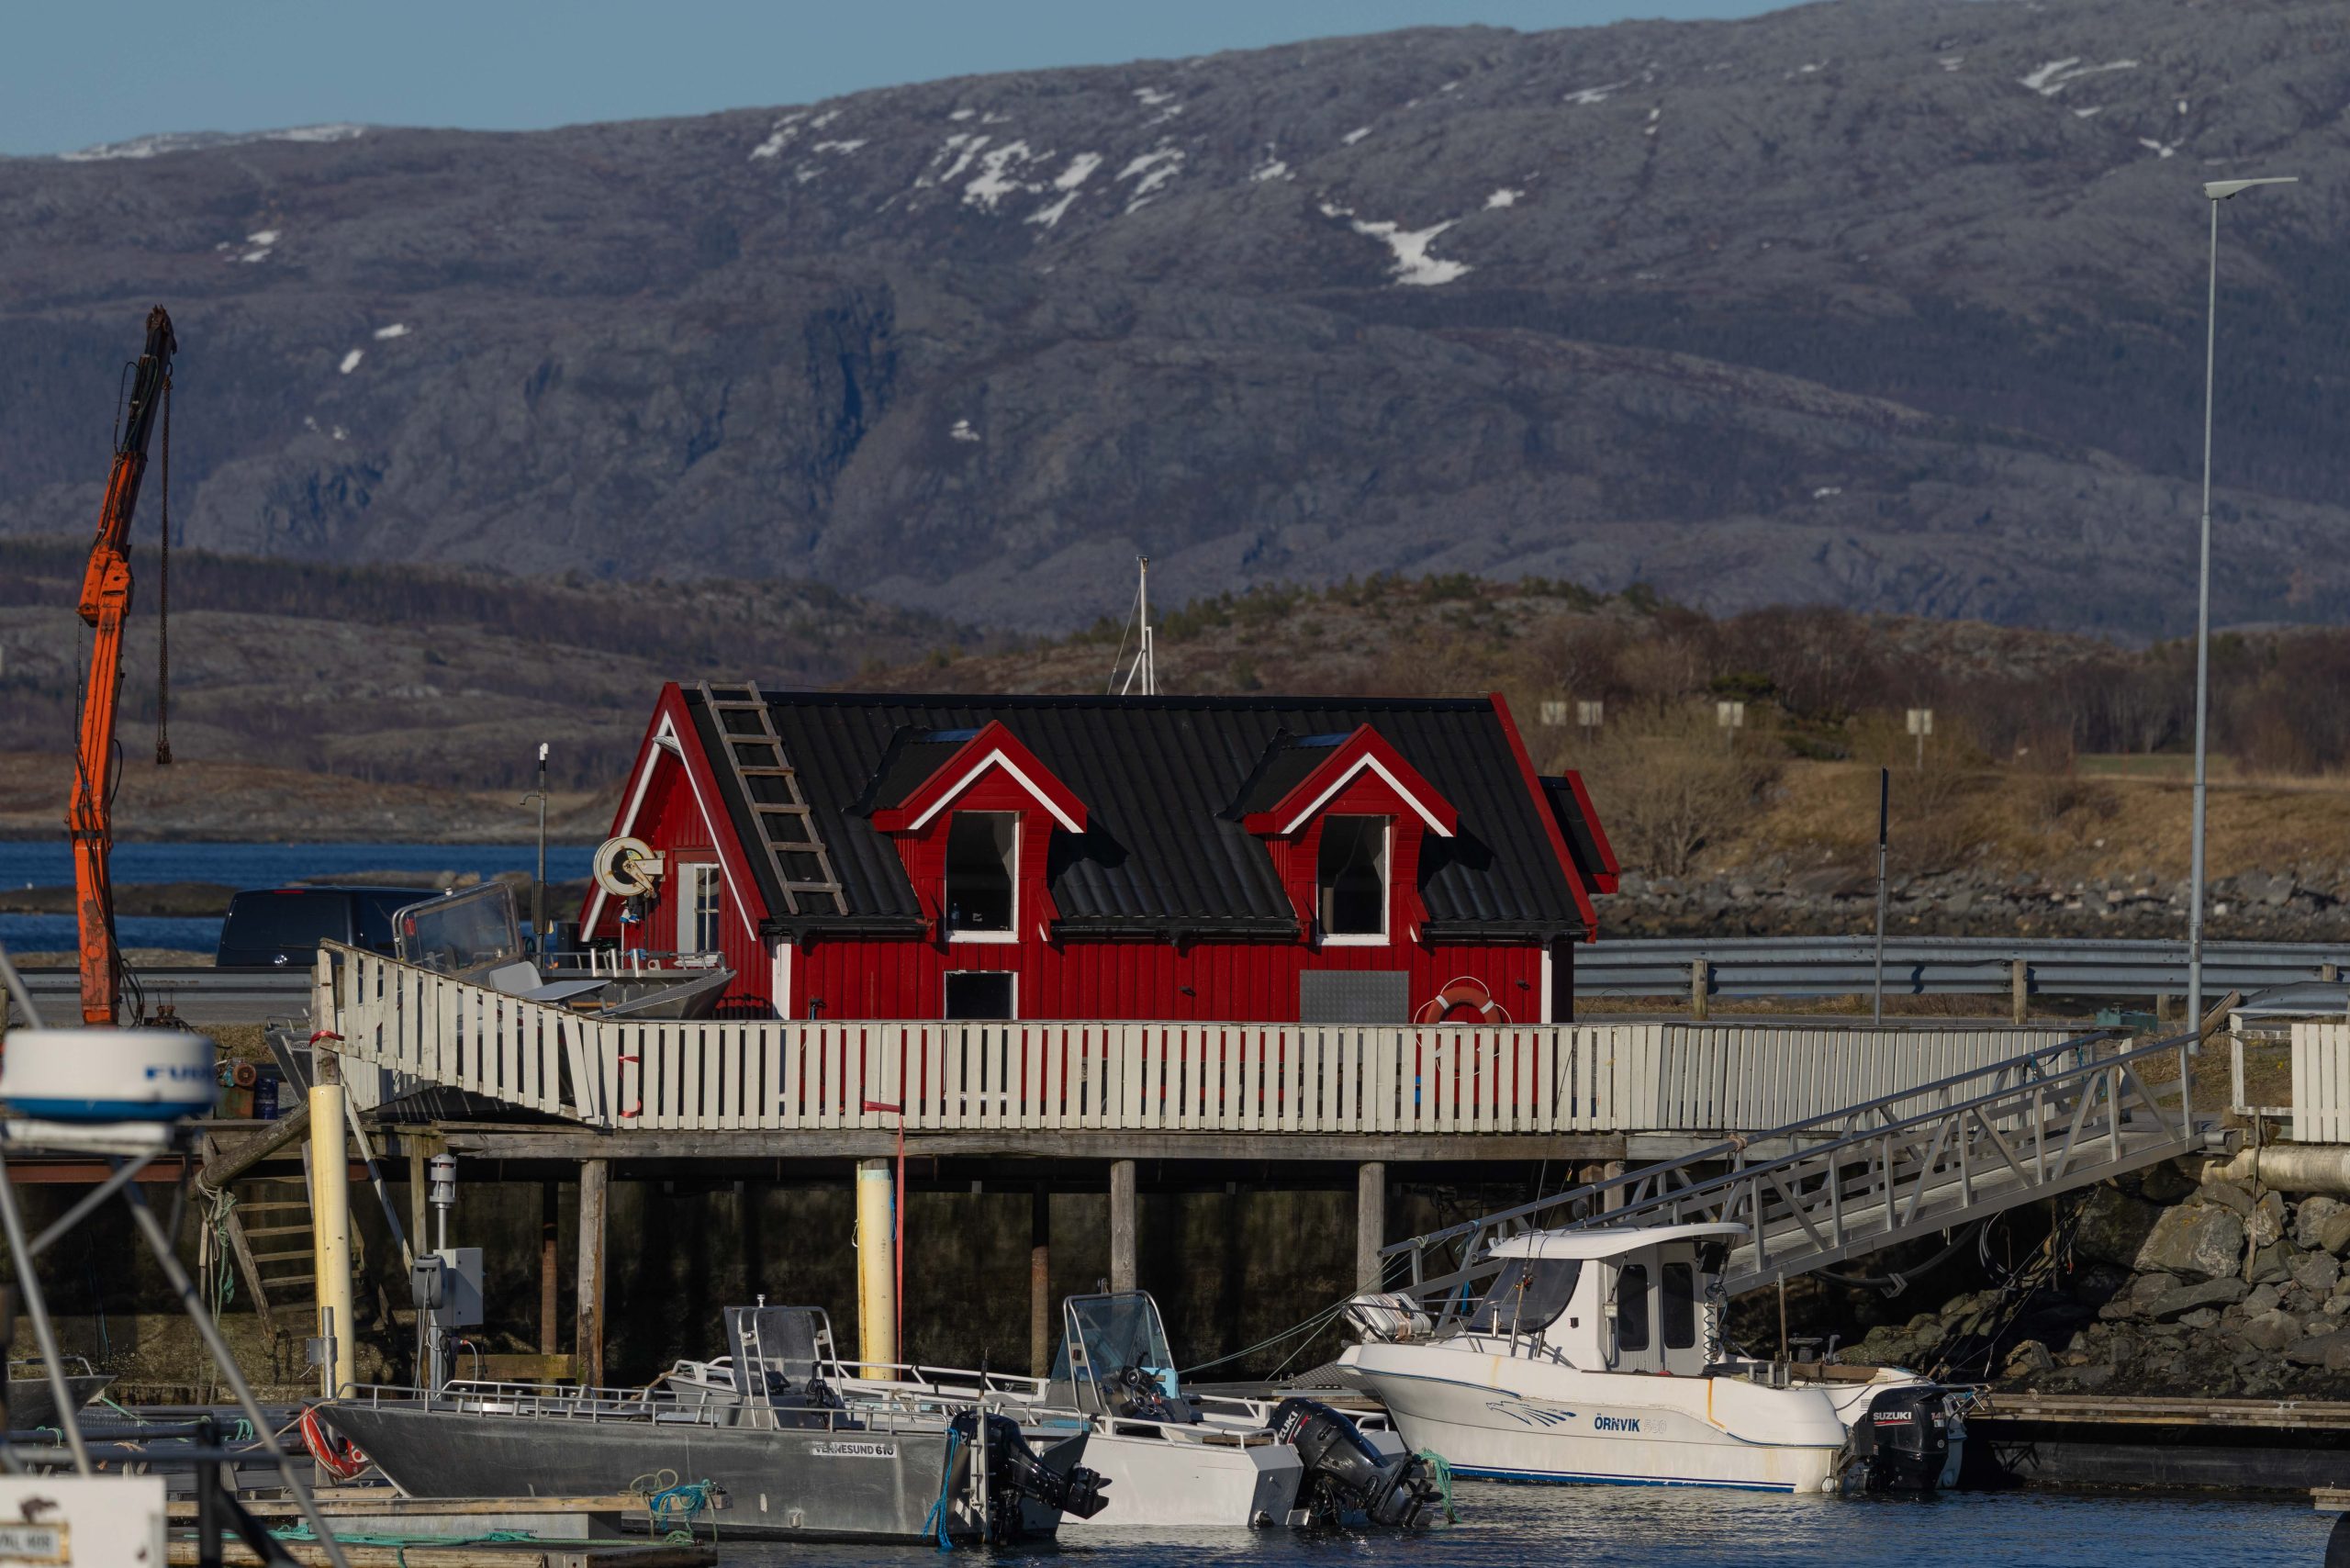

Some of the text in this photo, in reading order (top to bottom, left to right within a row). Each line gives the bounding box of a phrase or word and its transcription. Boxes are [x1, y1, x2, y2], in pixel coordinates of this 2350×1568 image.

[1278, 1411, 1299, 1439] ZUKI
[1595, 1413, 1641, 1433] ÖRNVIK
[1873, 1412, 1912, 1420] SUZUKI
